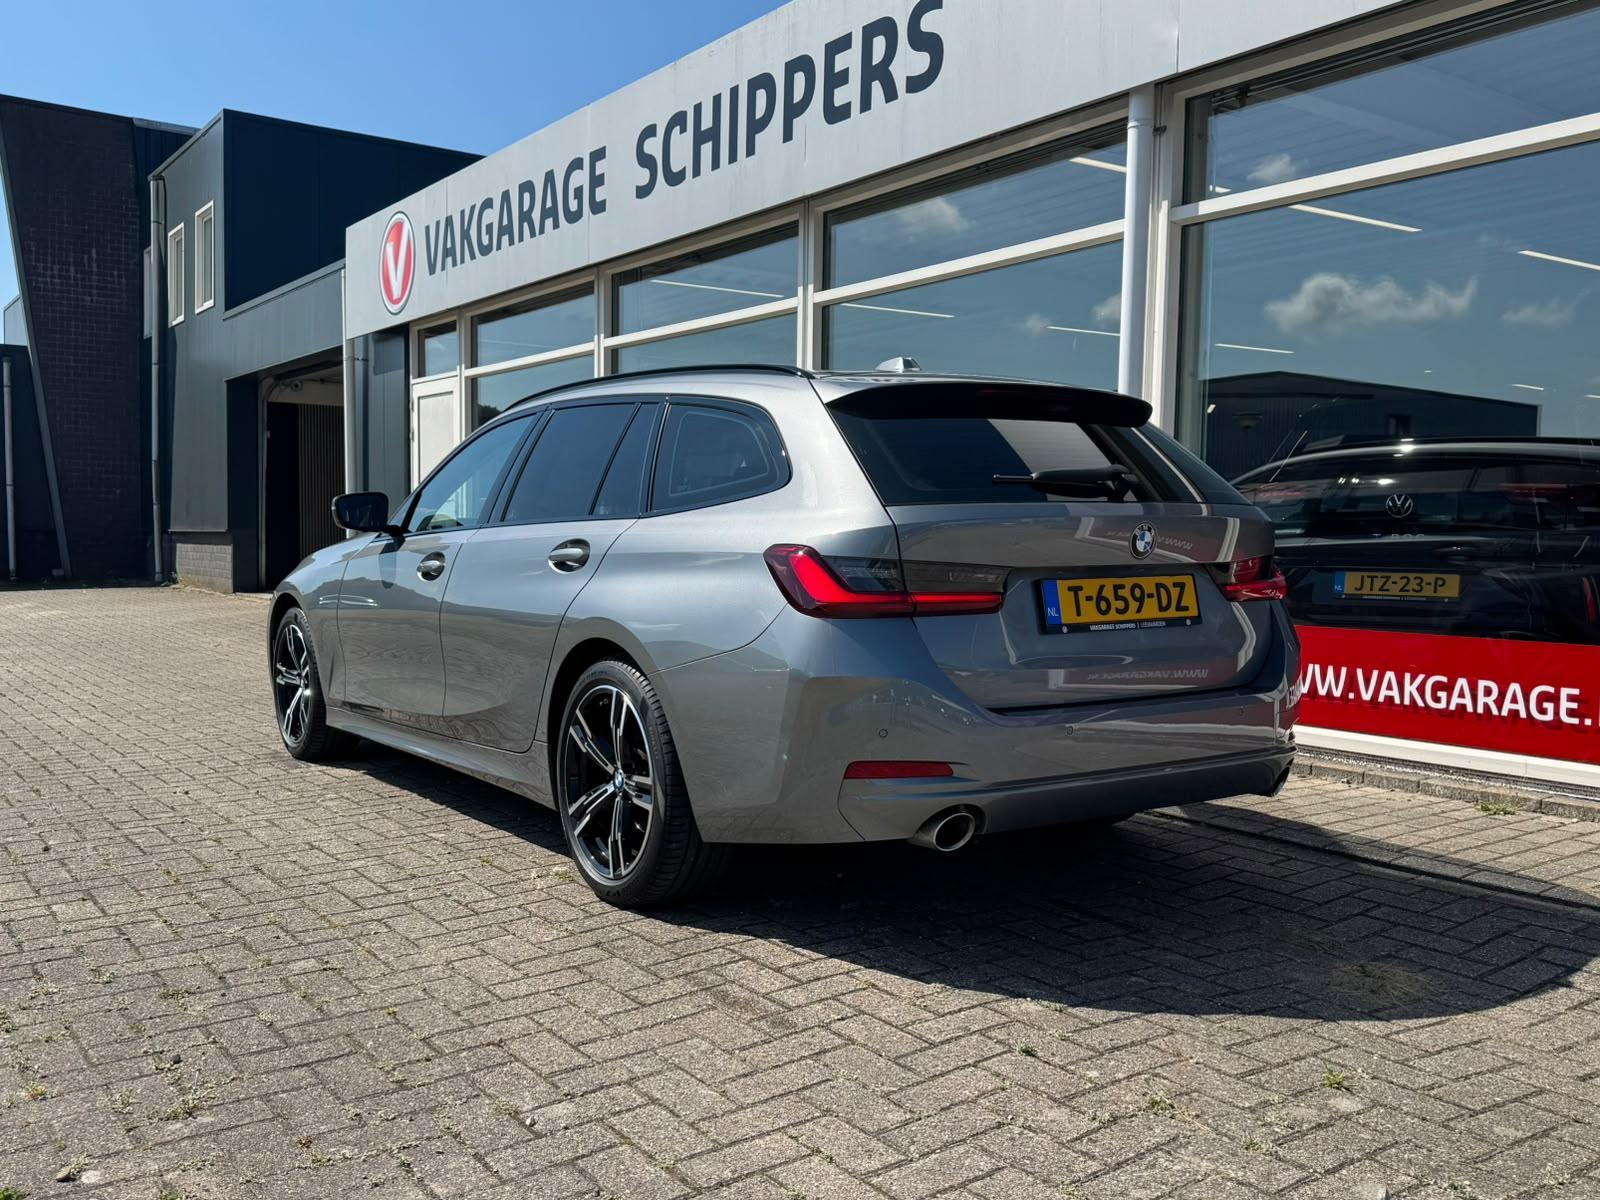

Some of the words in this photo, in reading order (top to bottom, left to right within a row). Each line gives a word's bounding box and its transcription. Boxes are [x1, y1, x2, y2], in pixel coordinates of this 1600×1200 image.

[425, 145, 607, 276] VAKGARAGE
[635, 0, 944, 200] SCHIPPERS
[1067, 582, 1190, 617] T-659-DZ
[1354, 575, 1447, 594] JTZ-23-P
[1047, 607, 1060, 617] NL
[1300, 663, 1600, 727] W.VAKGARAGE.
